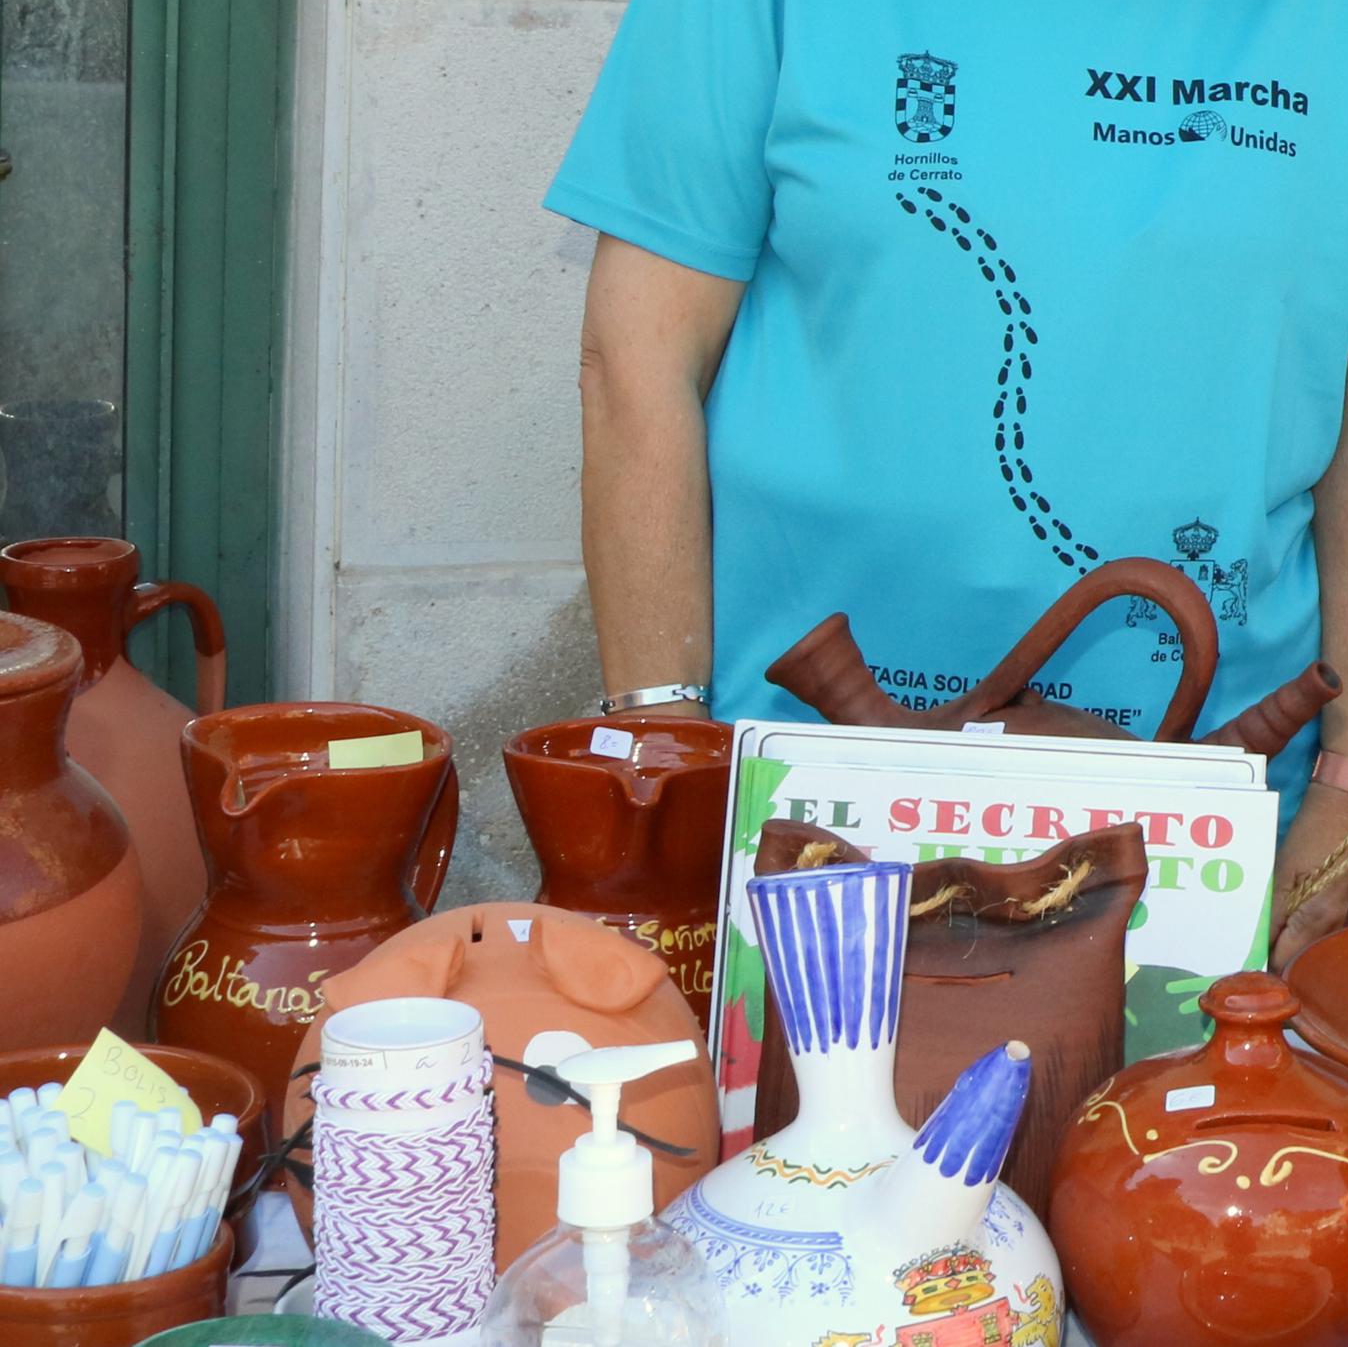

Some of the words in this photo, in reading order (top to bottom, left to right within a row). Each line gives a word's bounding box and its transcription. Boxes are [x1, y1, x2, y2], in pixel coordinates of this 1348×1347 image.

[1085, 68, 1156, 102] XXI
[1172, 78, 1309, 115] Marcha
[1093, 122, 1174, 146] Manos
[1230, 126, 1297, 158] Unidas
[888, 169, 905, 182] de
[909, 168, 963, 182] Cerrato
[894, 152, 958, 166] Hornillos
[785, 798, 862, 828] EL
[888, 797, 1234, 849] SECRETO
